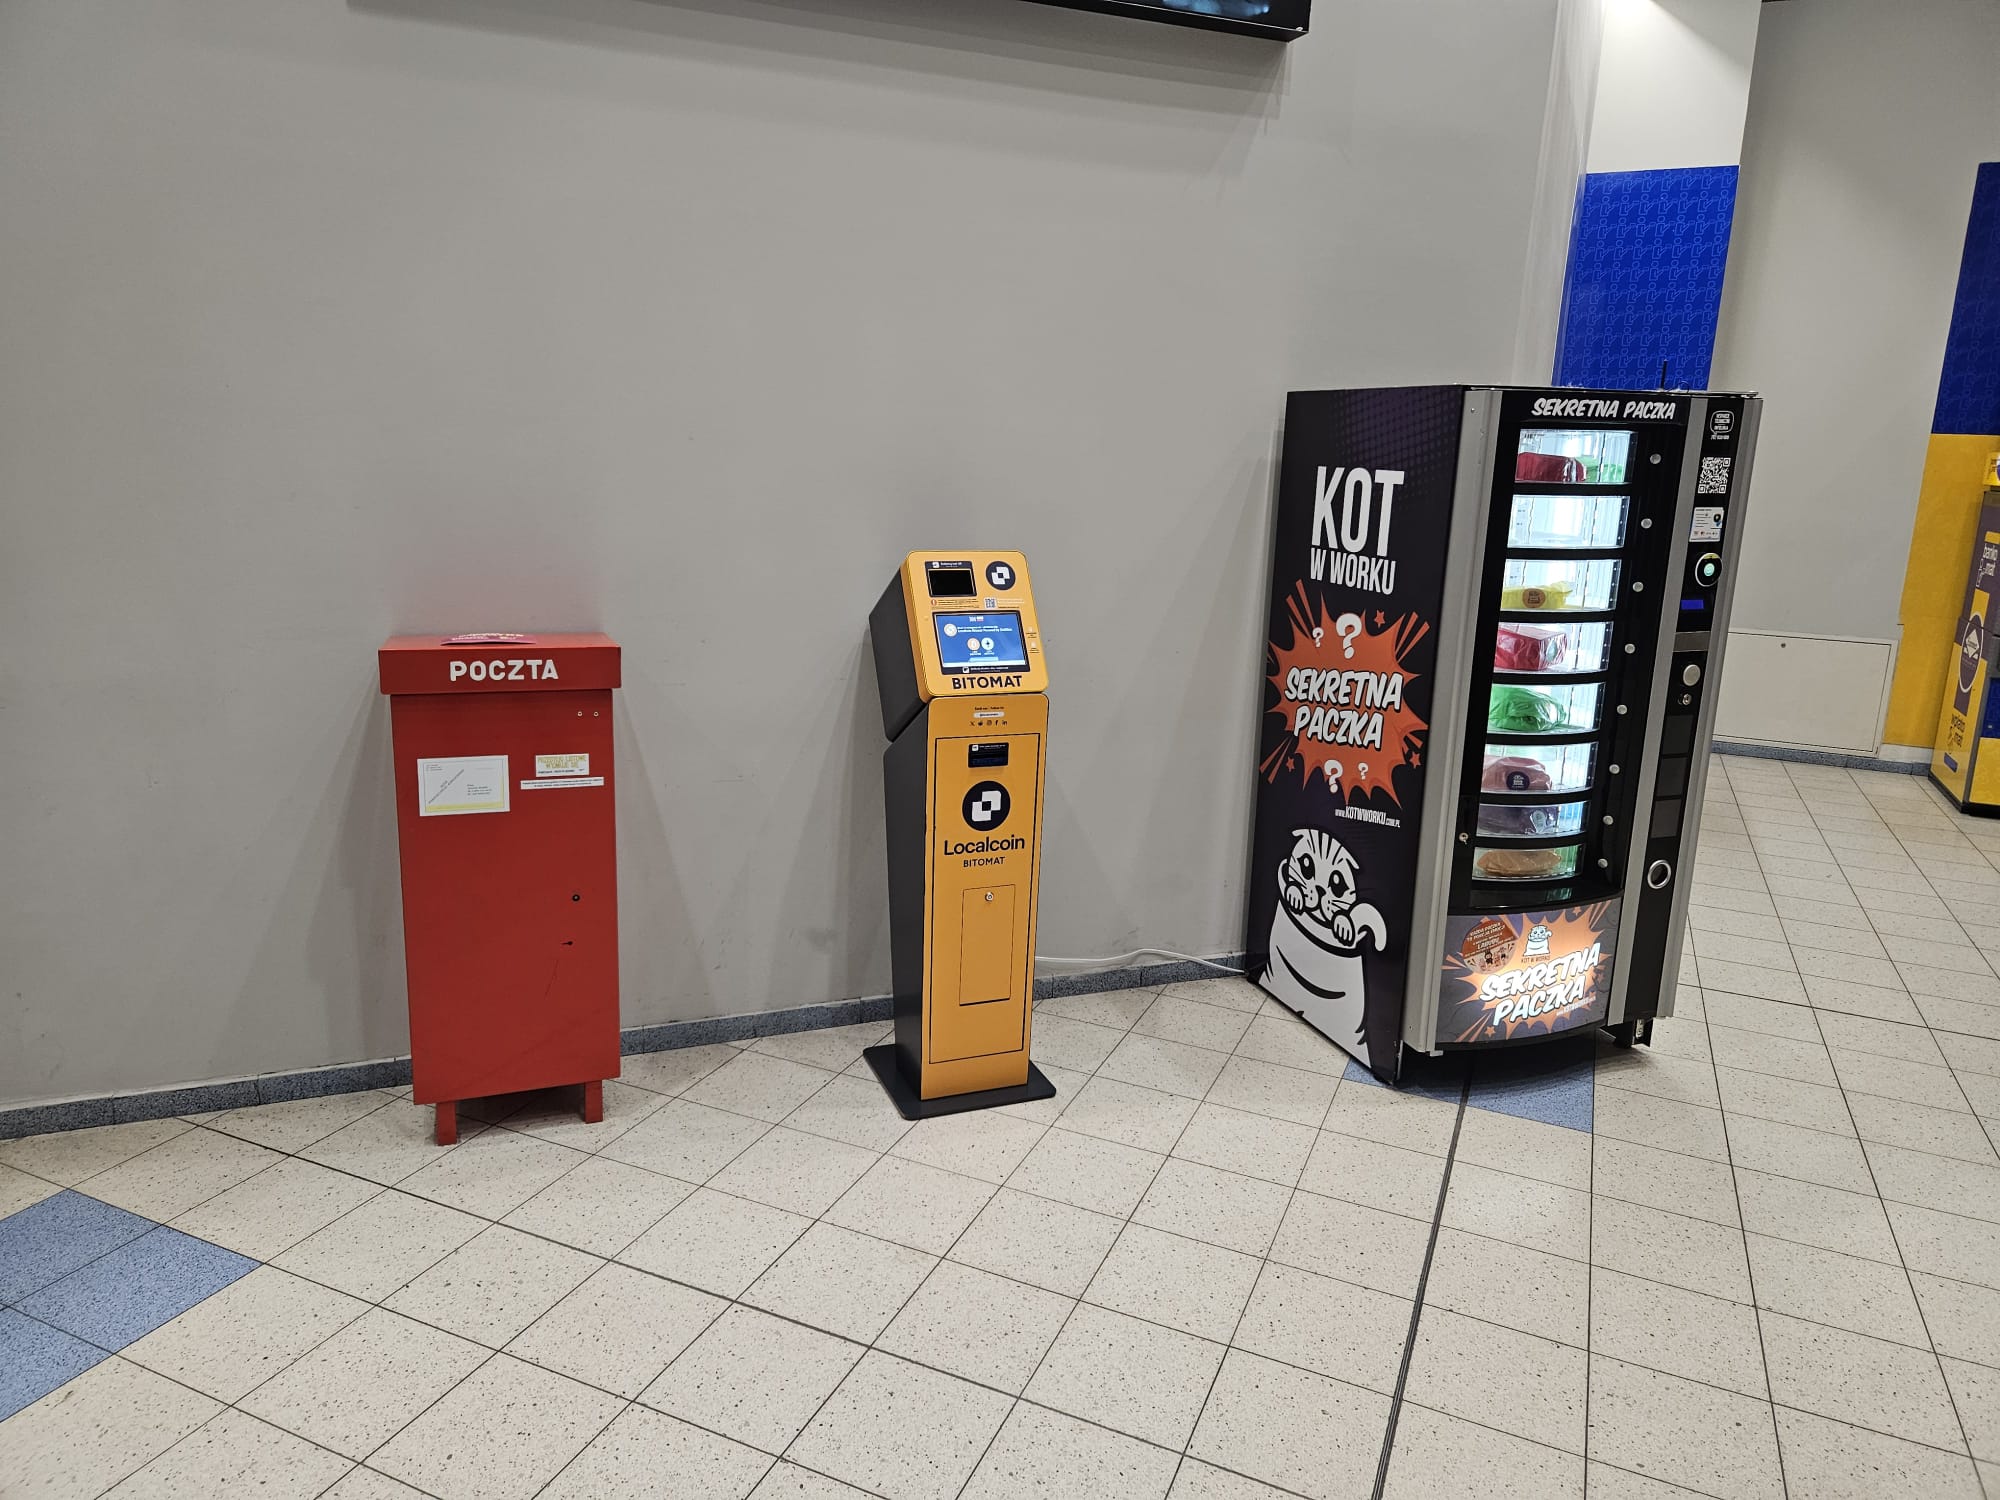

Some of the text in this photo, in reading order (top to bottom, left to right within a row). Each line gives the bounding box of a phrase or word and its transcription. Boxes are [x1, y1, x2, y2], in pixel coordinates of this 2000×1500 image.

[1531, 397, 1676, 420] SEKRETNA PACZKA
[1311, 465, 1405, 557] KOT
[1310, 547, 1396, 595] W WORKU
[450, 659, 559, 682] POCZTA
[952, 675, 1023, 690] BITOMAT
[1284, 667, 1403, 711] SEKRETNA
[1293, 706, 1384, 749] PACZKA
[944, 834, 1026, 855] Localcoin
[963, 856, 1005, 867] BITOMAT
[1479, 942, 1601, 1002] SEKRETNA
[1492, 974, 1586, 1027] PACZKA
